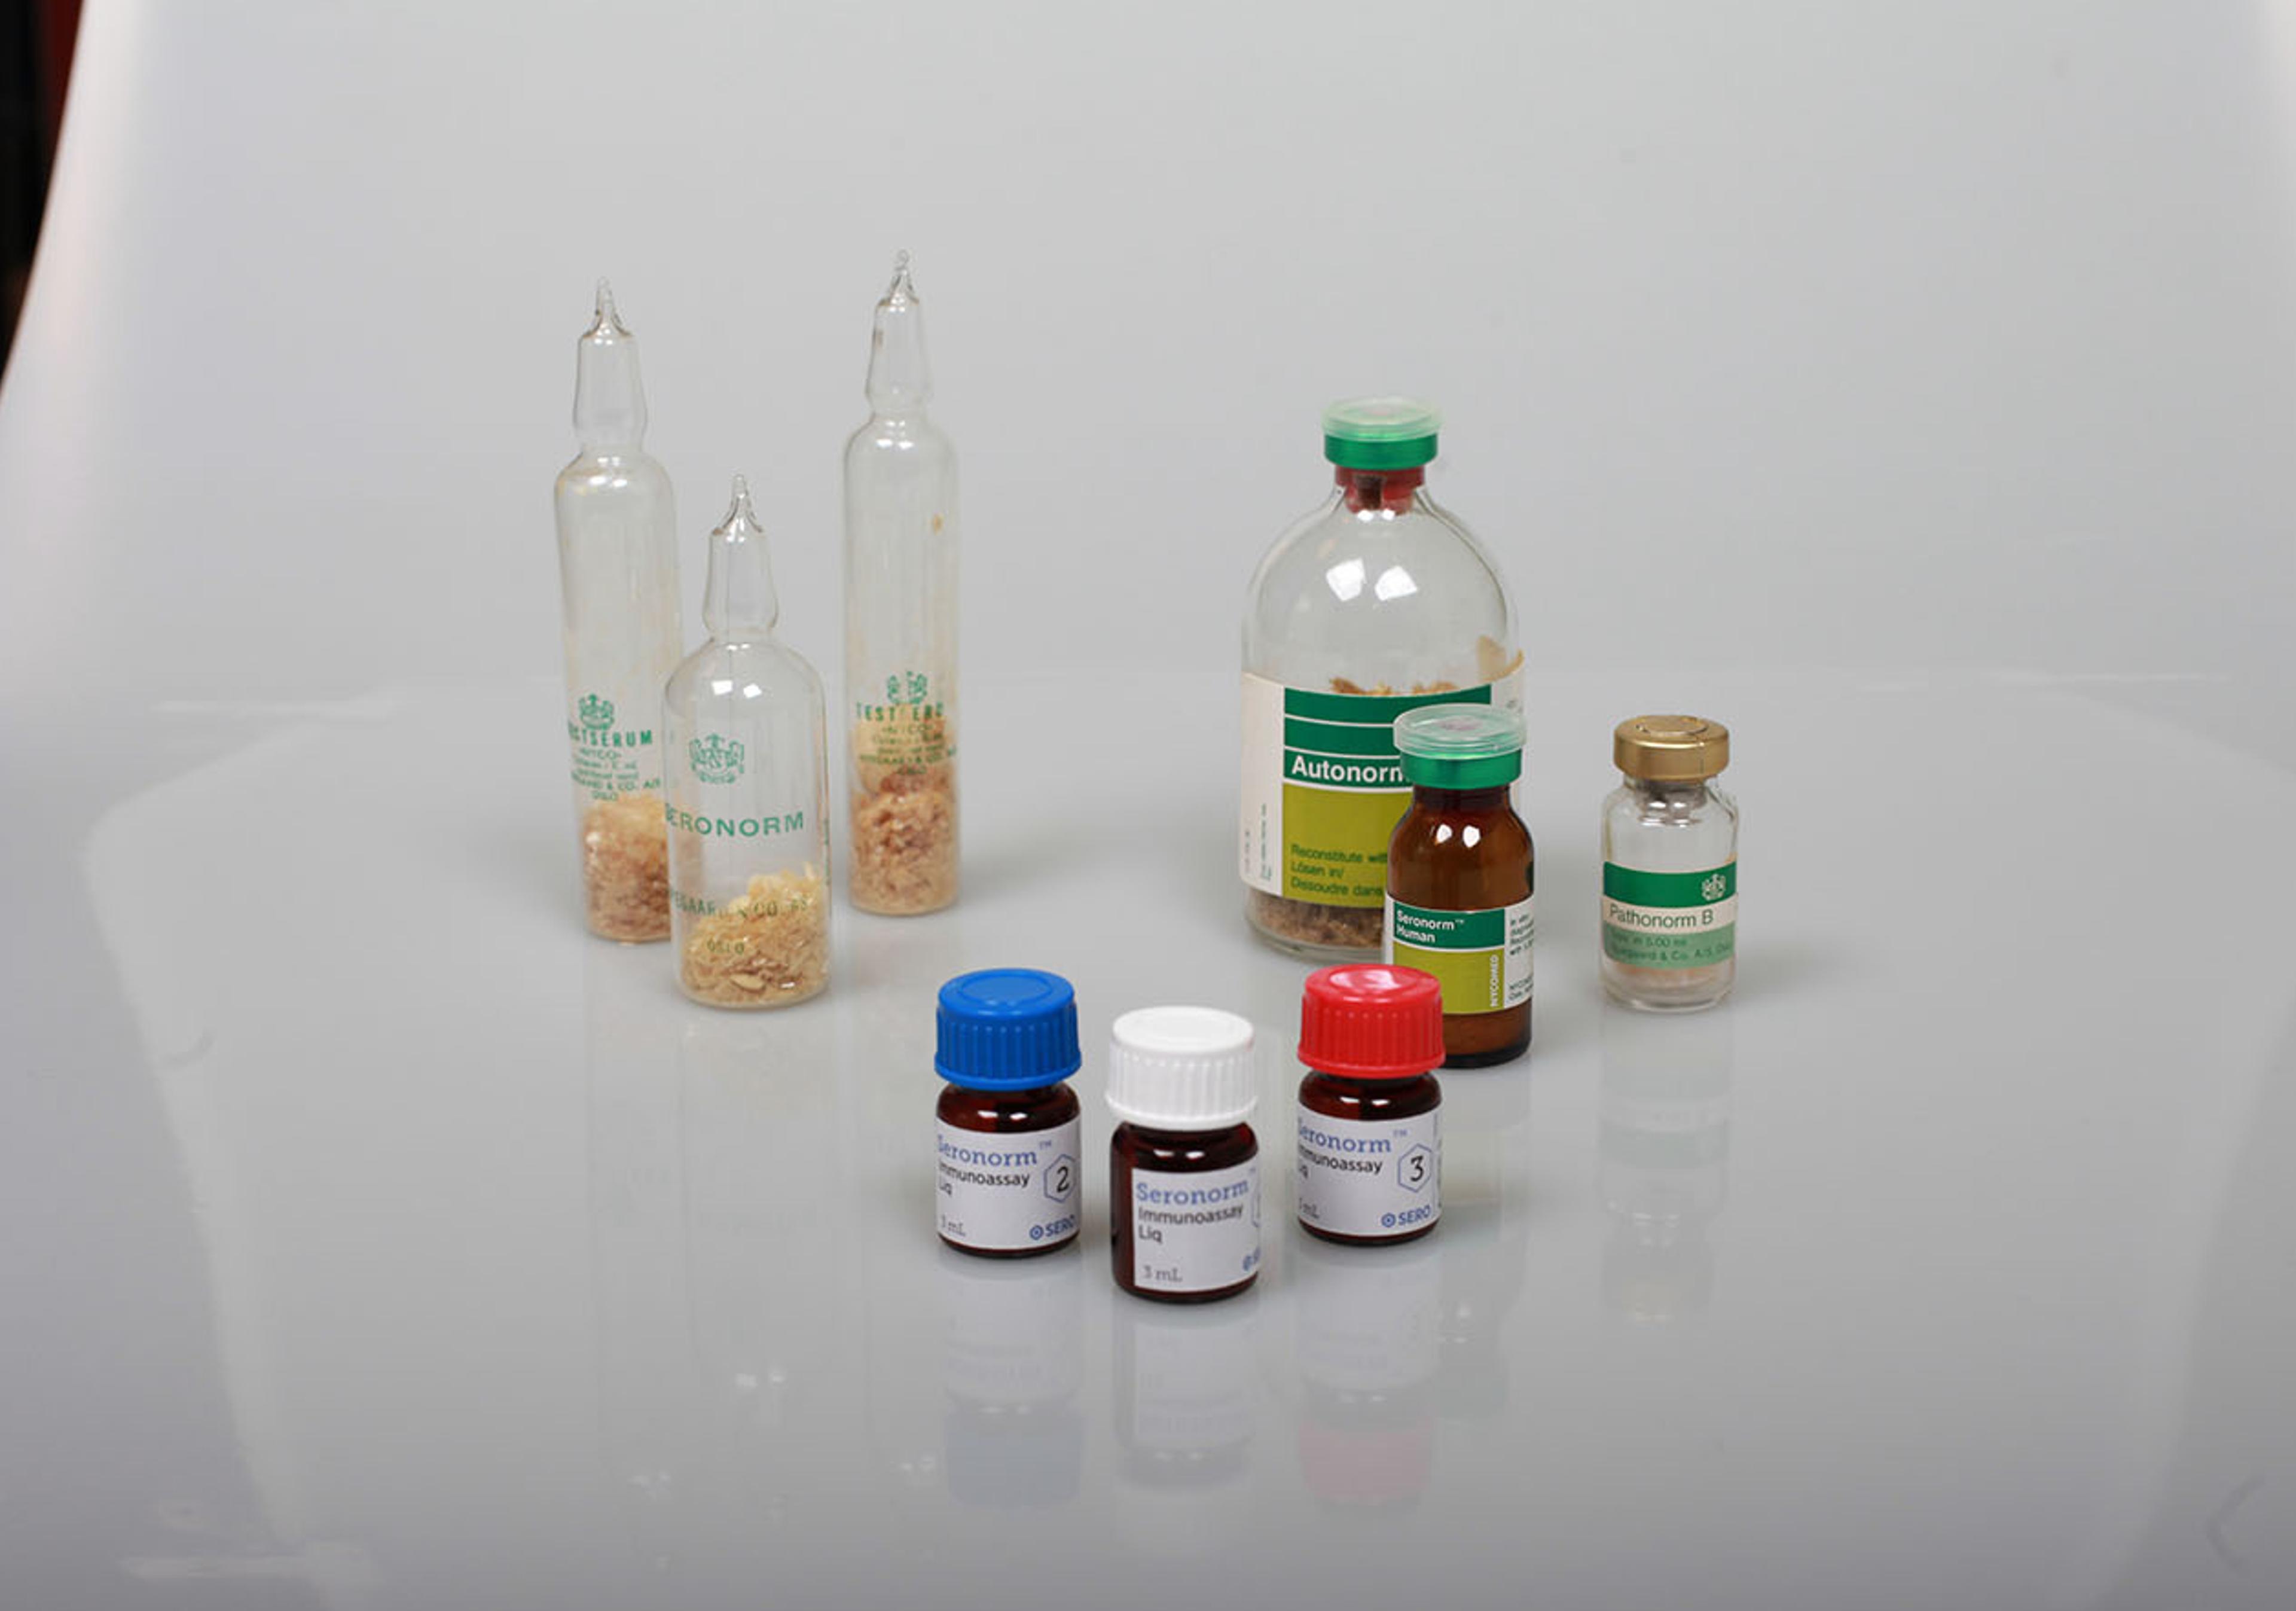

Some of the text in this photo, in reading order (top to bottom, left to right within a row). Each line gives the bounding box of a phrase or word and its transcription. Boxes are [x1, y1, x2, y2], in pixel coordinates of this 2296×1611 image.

[1609, 903, 1714, 929] Pathonorm B
[1396, 924, 1436, 944] Human
[1489, 954, 1500, 1008] NYCOMED
[1057, 1166, 1070, 1194] 2
[1410, 1155, 1424, 1182] 3
[1138, 1204, 1244, 1225] Immunoassay
[1138, 1225, 1164, 1246] Liq
[1143, 1264, 1183, 1283] 3 mL
